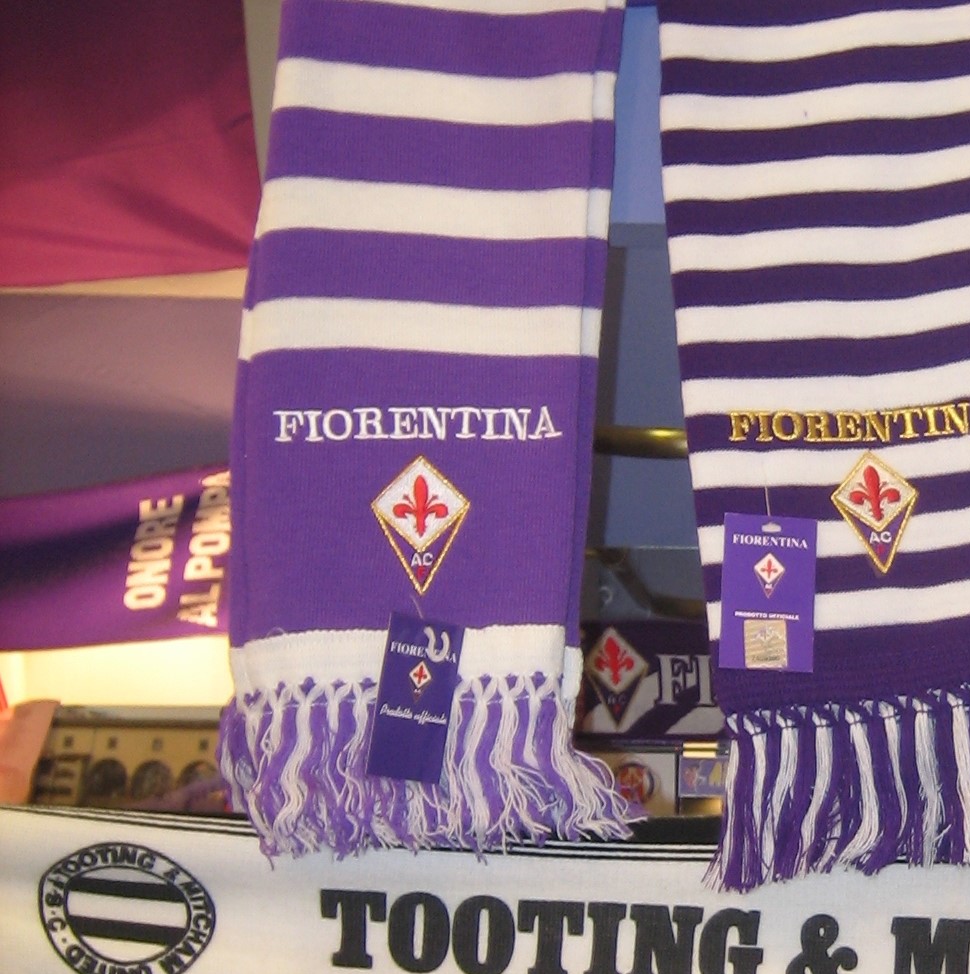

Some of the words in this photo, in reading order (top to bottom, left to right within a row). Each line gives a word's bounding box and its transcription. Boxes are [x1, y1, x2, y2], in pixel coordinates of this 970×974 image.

[273, 405, 563, 442] FIORENTINA
[123, 494, 185, 611] ONORE
[732, 533, 809, 550] FIORENTINA
[869, 531, 893, 545] AC
[410, 552, 434, 567] AC
[176, 582, 222, 628] AL
[52, 845, 157, 880] TOOTING
